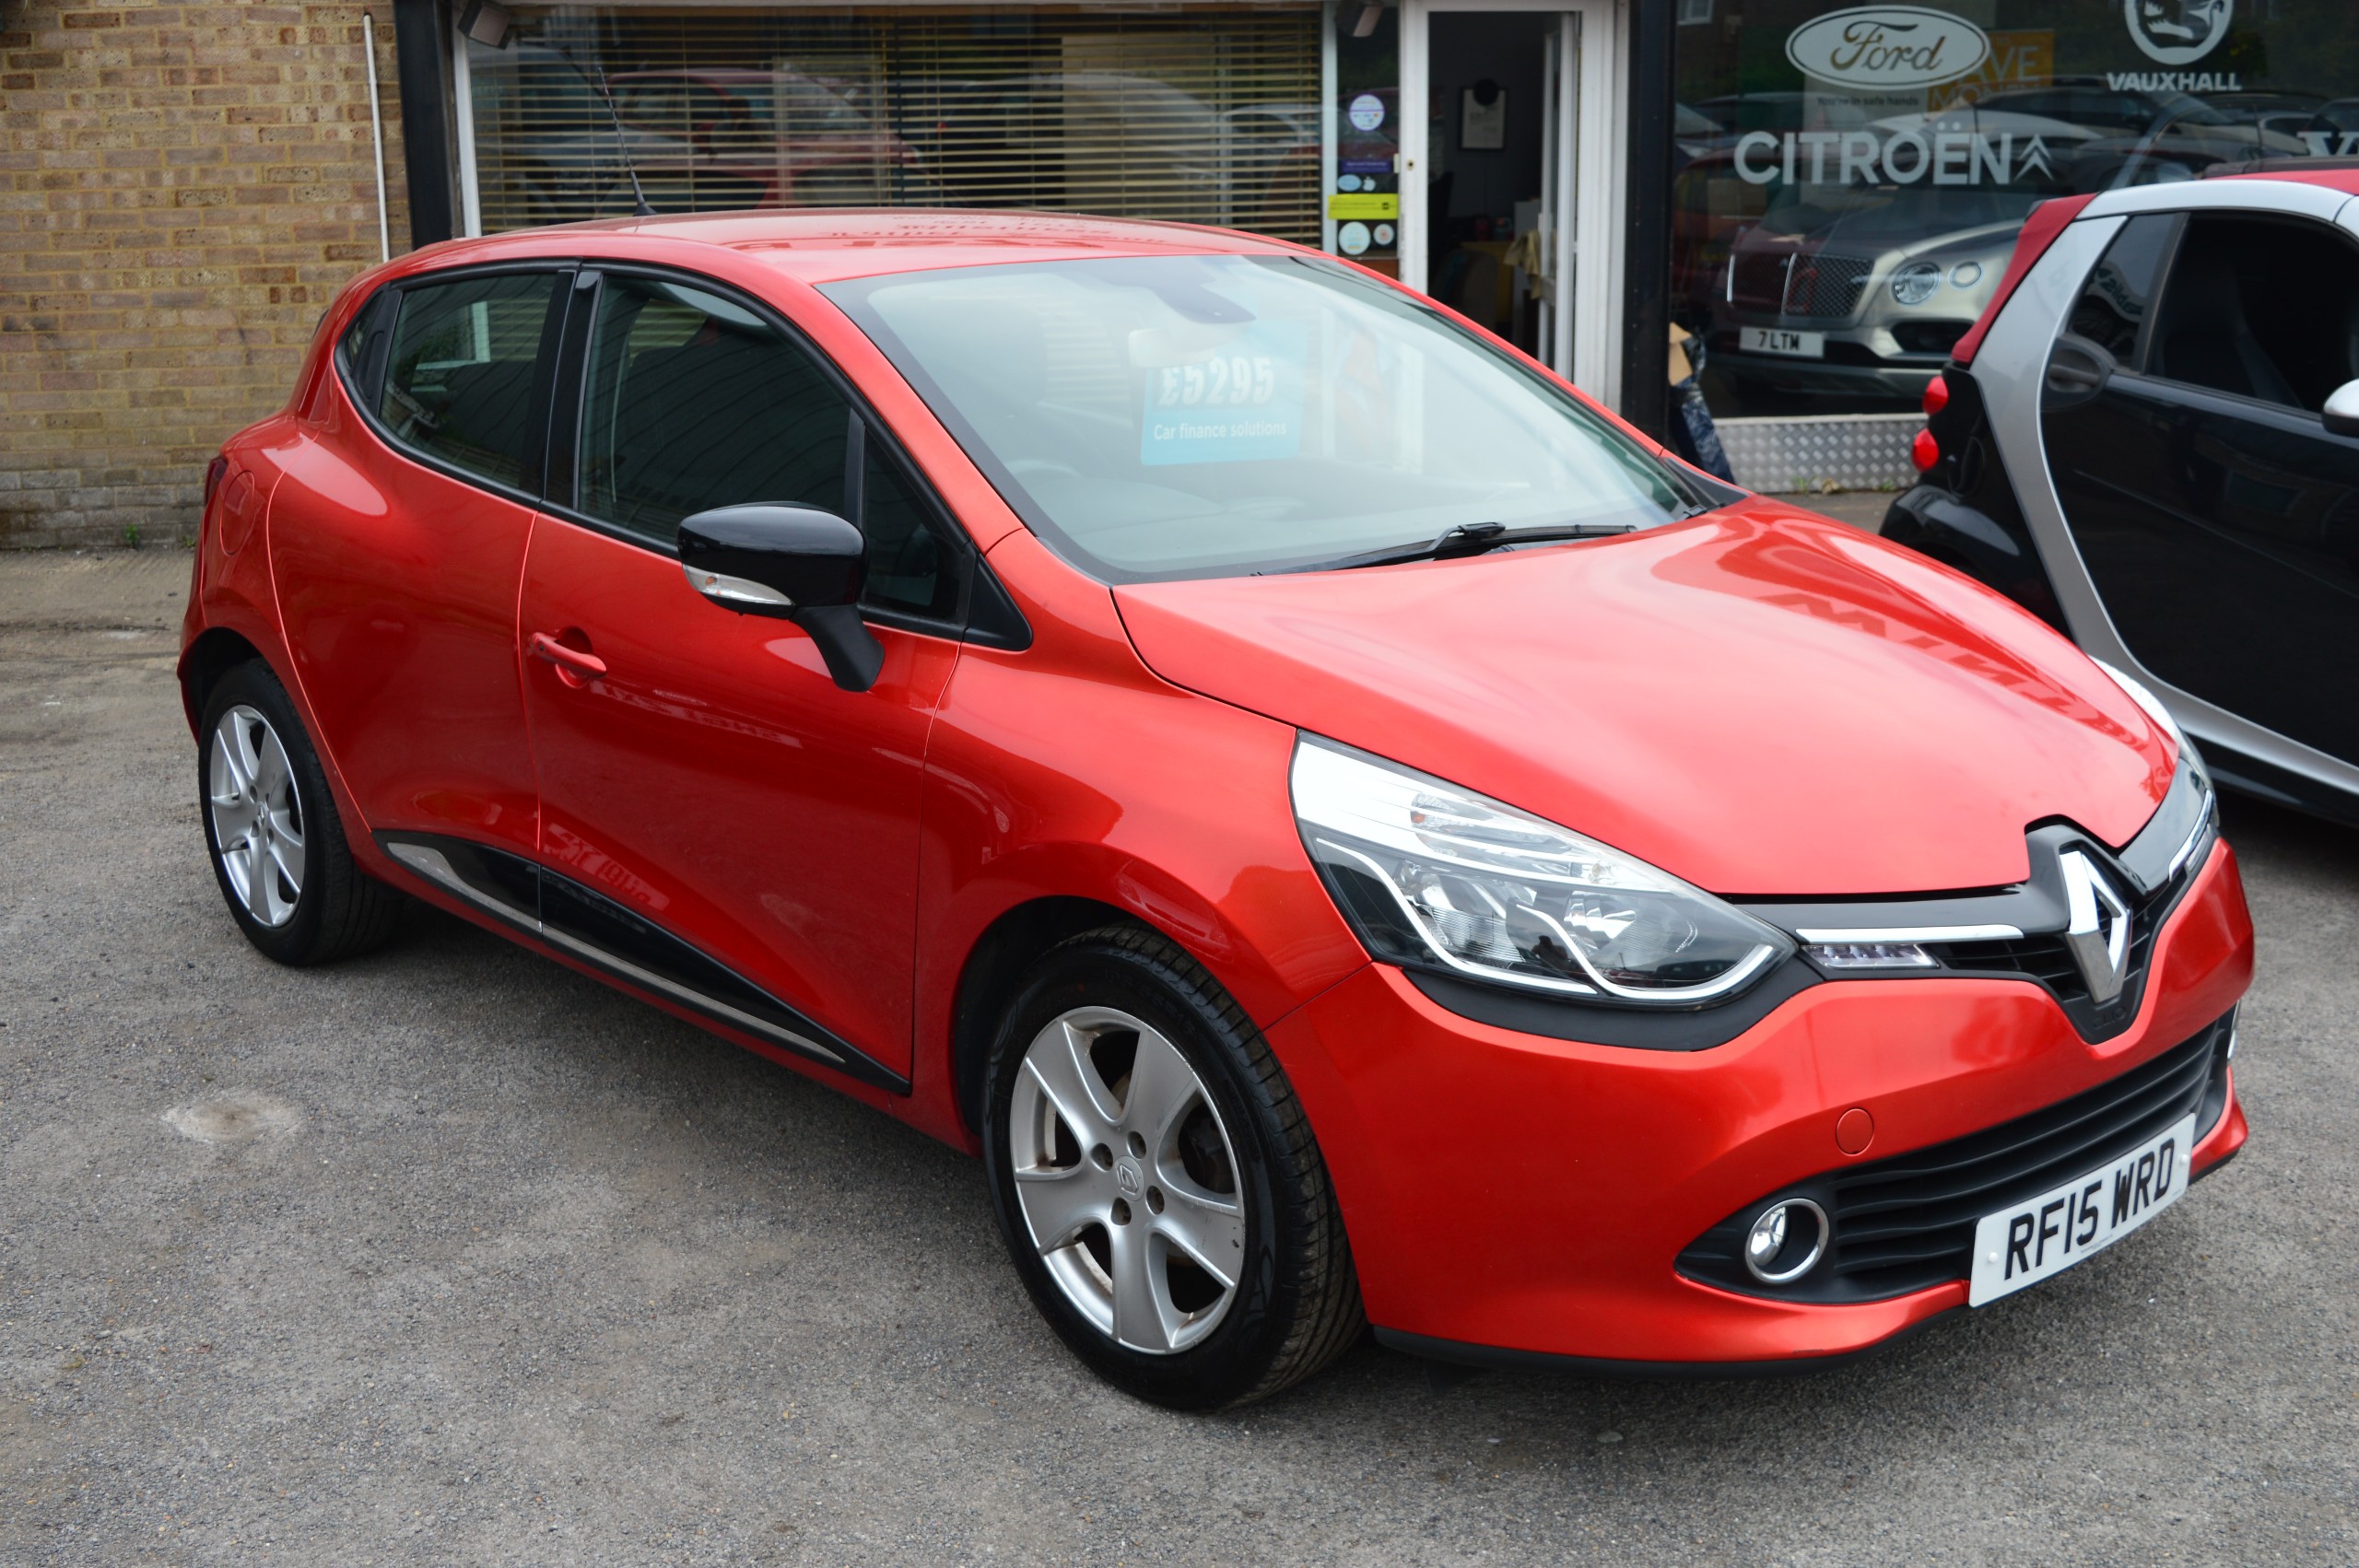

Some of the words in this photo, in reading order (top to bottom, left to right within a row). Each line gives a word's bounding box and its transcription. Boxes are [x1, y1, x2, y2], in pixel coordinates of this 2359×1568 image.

[1830, 20, 1946, 71] Ford
[1887, 96, 1919, 107] hands
[2106, 71, 2243, 92] VAUXHALL
[1733, 121, 2013, 185] CITROËN
[1156, 357, 1275, 406] £5295
[1154, 424, 1175, 440] Car
[1180, 422, 1227, 439] finance
[1230, 420, 1287, 438] solutions
[2004, 1179, 2103, 1281] RF15
[2110, 1137, 2175, 1230] WRD
